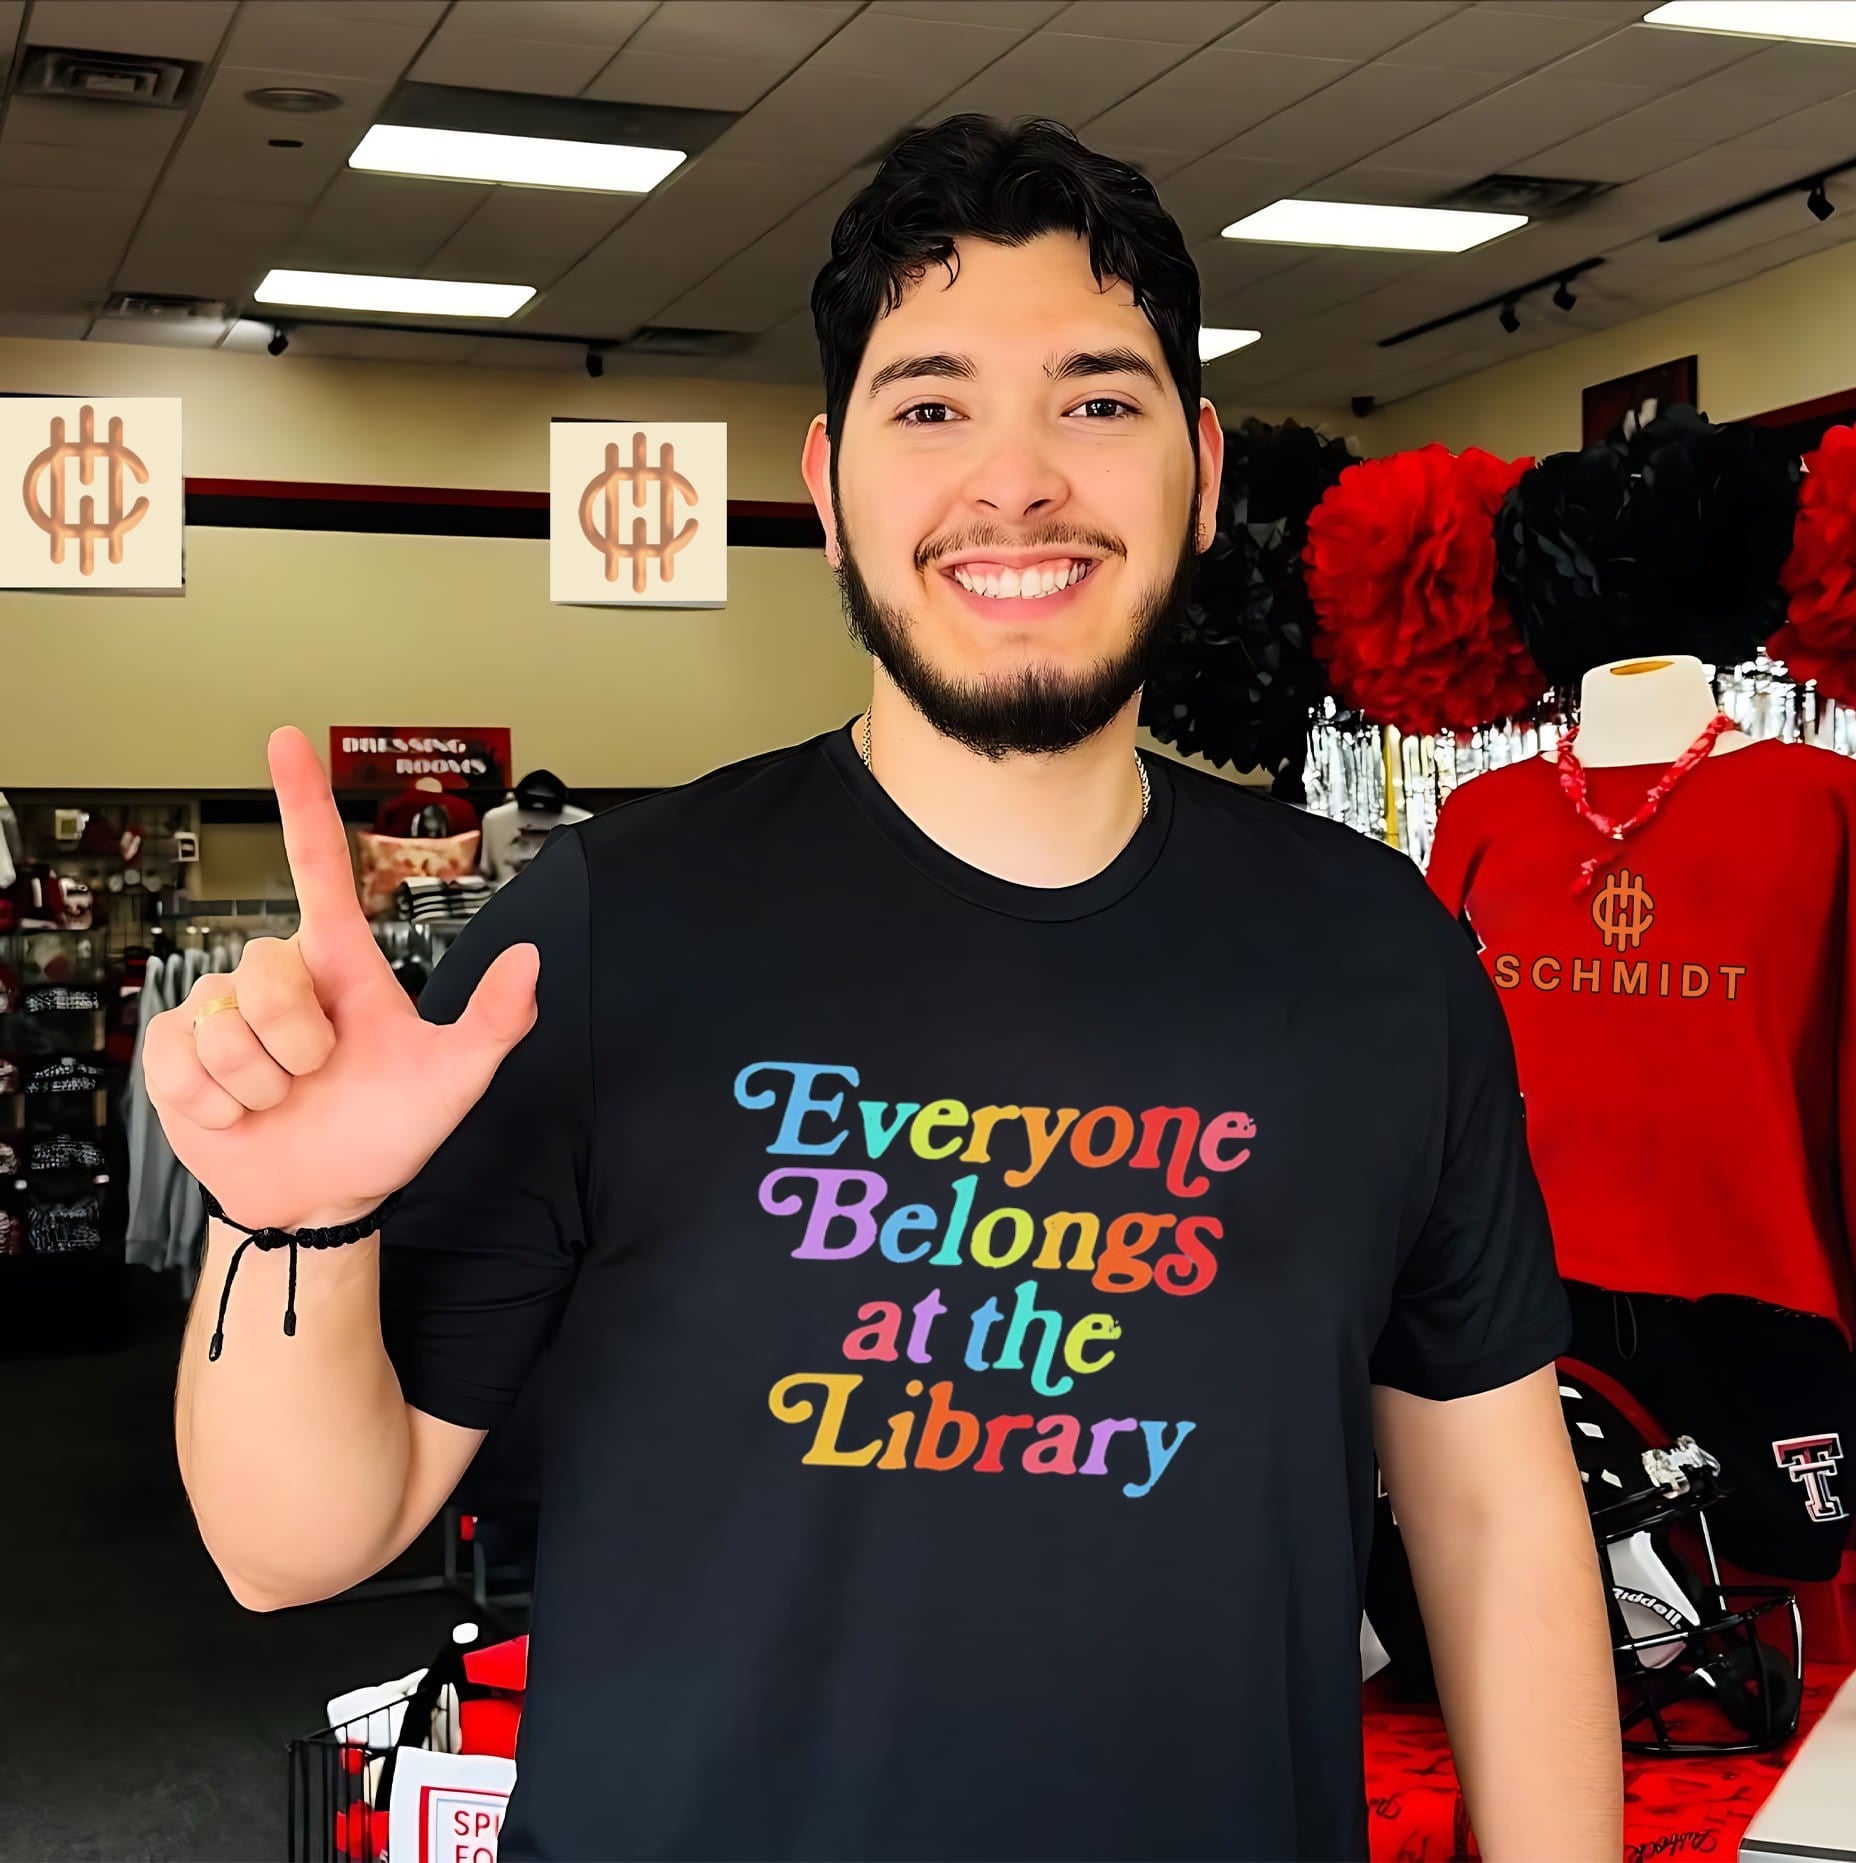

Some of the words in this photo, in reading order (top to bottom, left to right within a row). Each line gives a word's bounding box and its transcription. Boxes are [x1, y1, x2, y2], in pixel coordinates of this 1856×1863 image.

[342, 737, 466, 753] DRESSING
[396, 758, 487, 775] ROOMS
[1494, 953, 1747, 1000] SCHMIDT
[734, 1061, 1256, 1197] Everyone
[758, 1166, 1223, 1295] Belongs
[842, 1288, 947, 1364] at
[964, 1280, 1122, 1396] the
[768, 1372, 1196, 1498] Library
